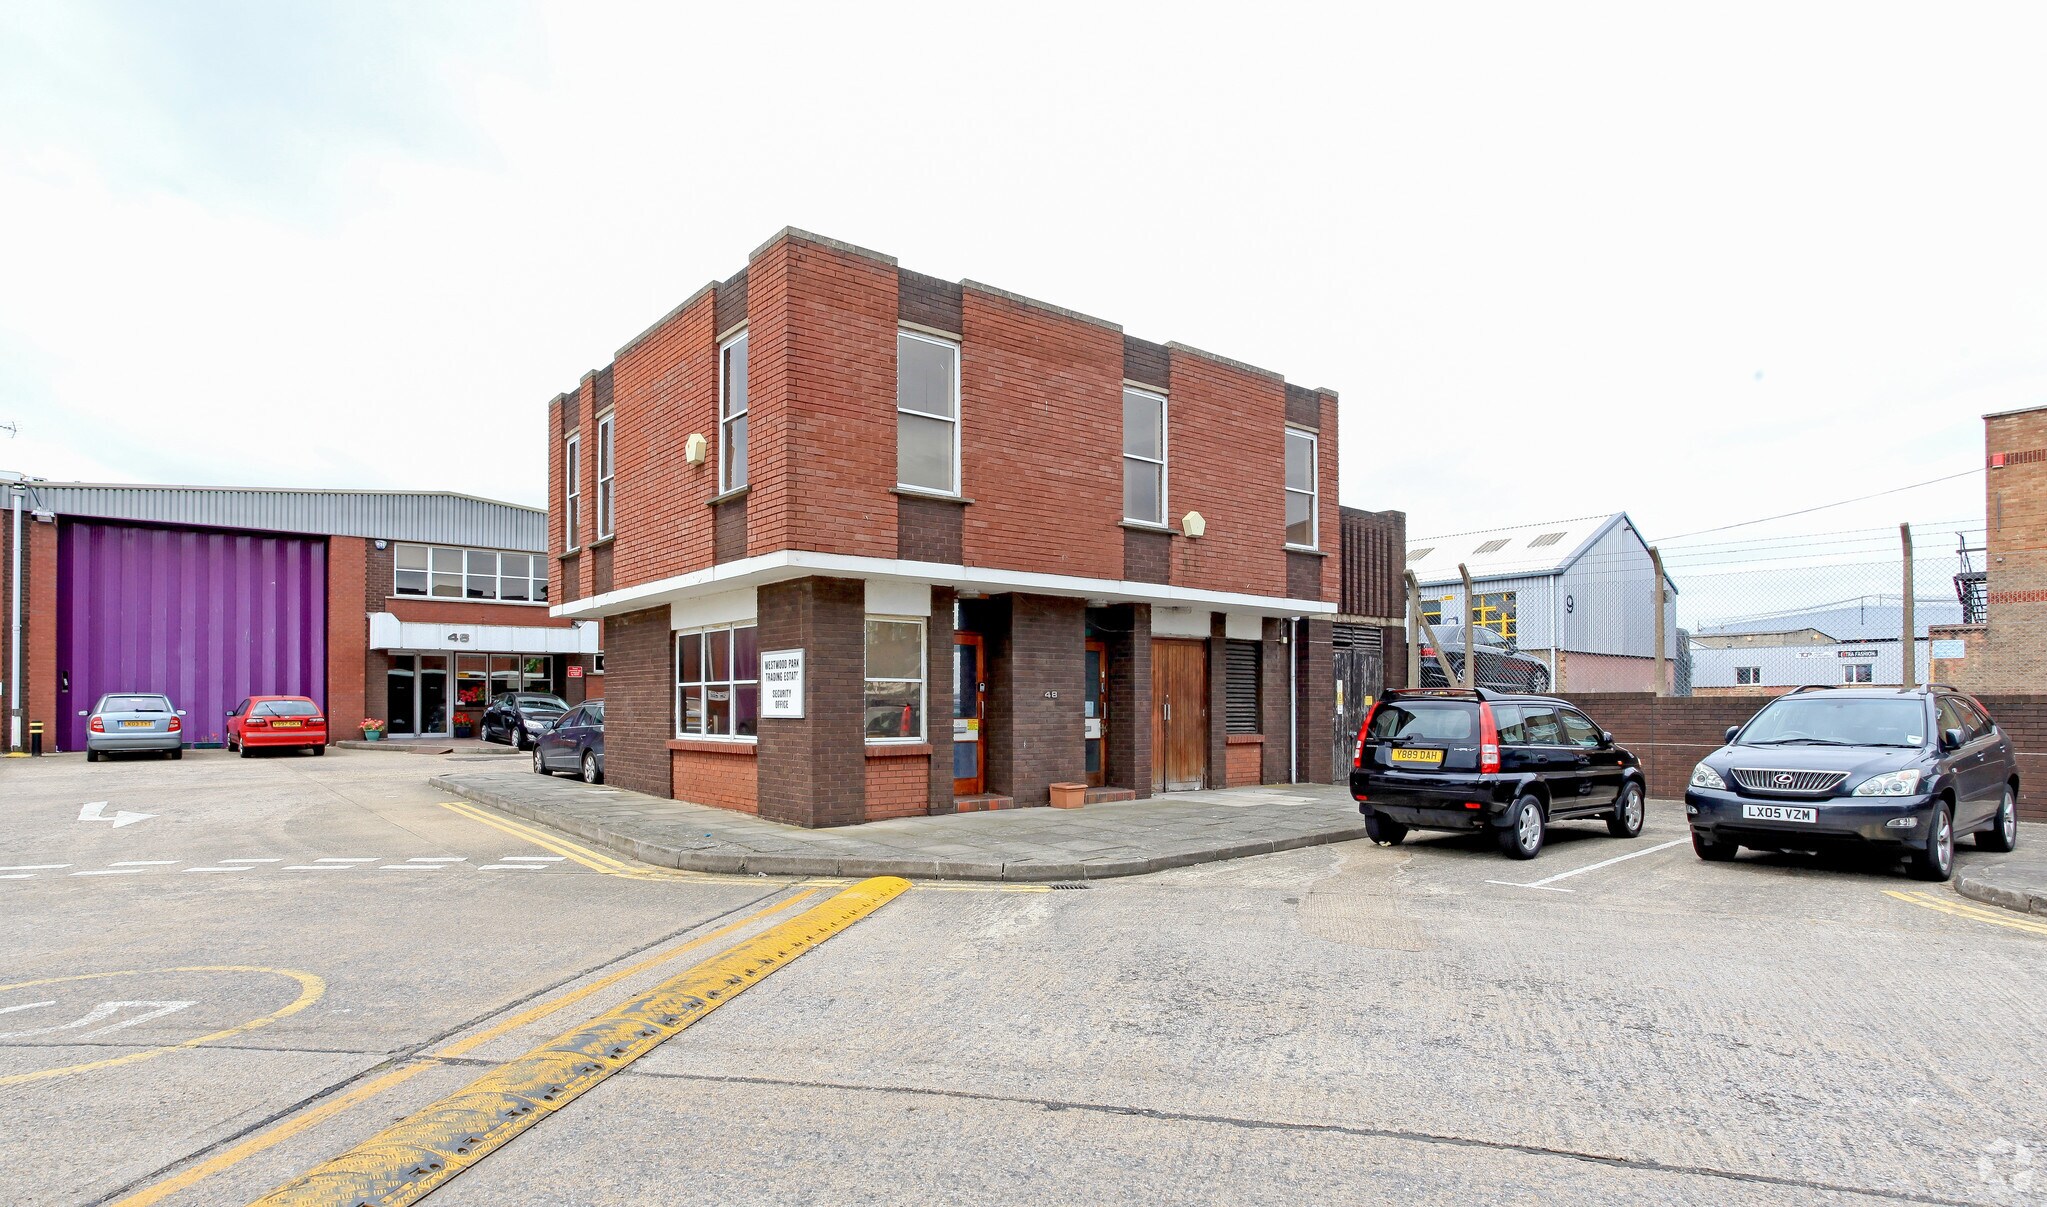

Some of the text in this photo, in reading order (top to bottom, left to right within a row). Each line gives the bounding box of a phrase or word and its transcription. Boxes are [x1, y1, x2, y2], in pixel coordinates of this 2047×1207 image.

[1566, 594, 1574, 614] 9
[447, 632, 471, 643] 48
[764, 658, 800, 670] WESTWOOD PARK
[765, 672, 783, 682] TRADING
[772, 689, 792, 698] SECURITY
[1044, 690, 1058, 699] 48
[775, 700, 789, 709] OFFICE
[1396, 750, 1438, 760] Y889 DAH
[1748, 806, 1810, 820] LX05 VZM
